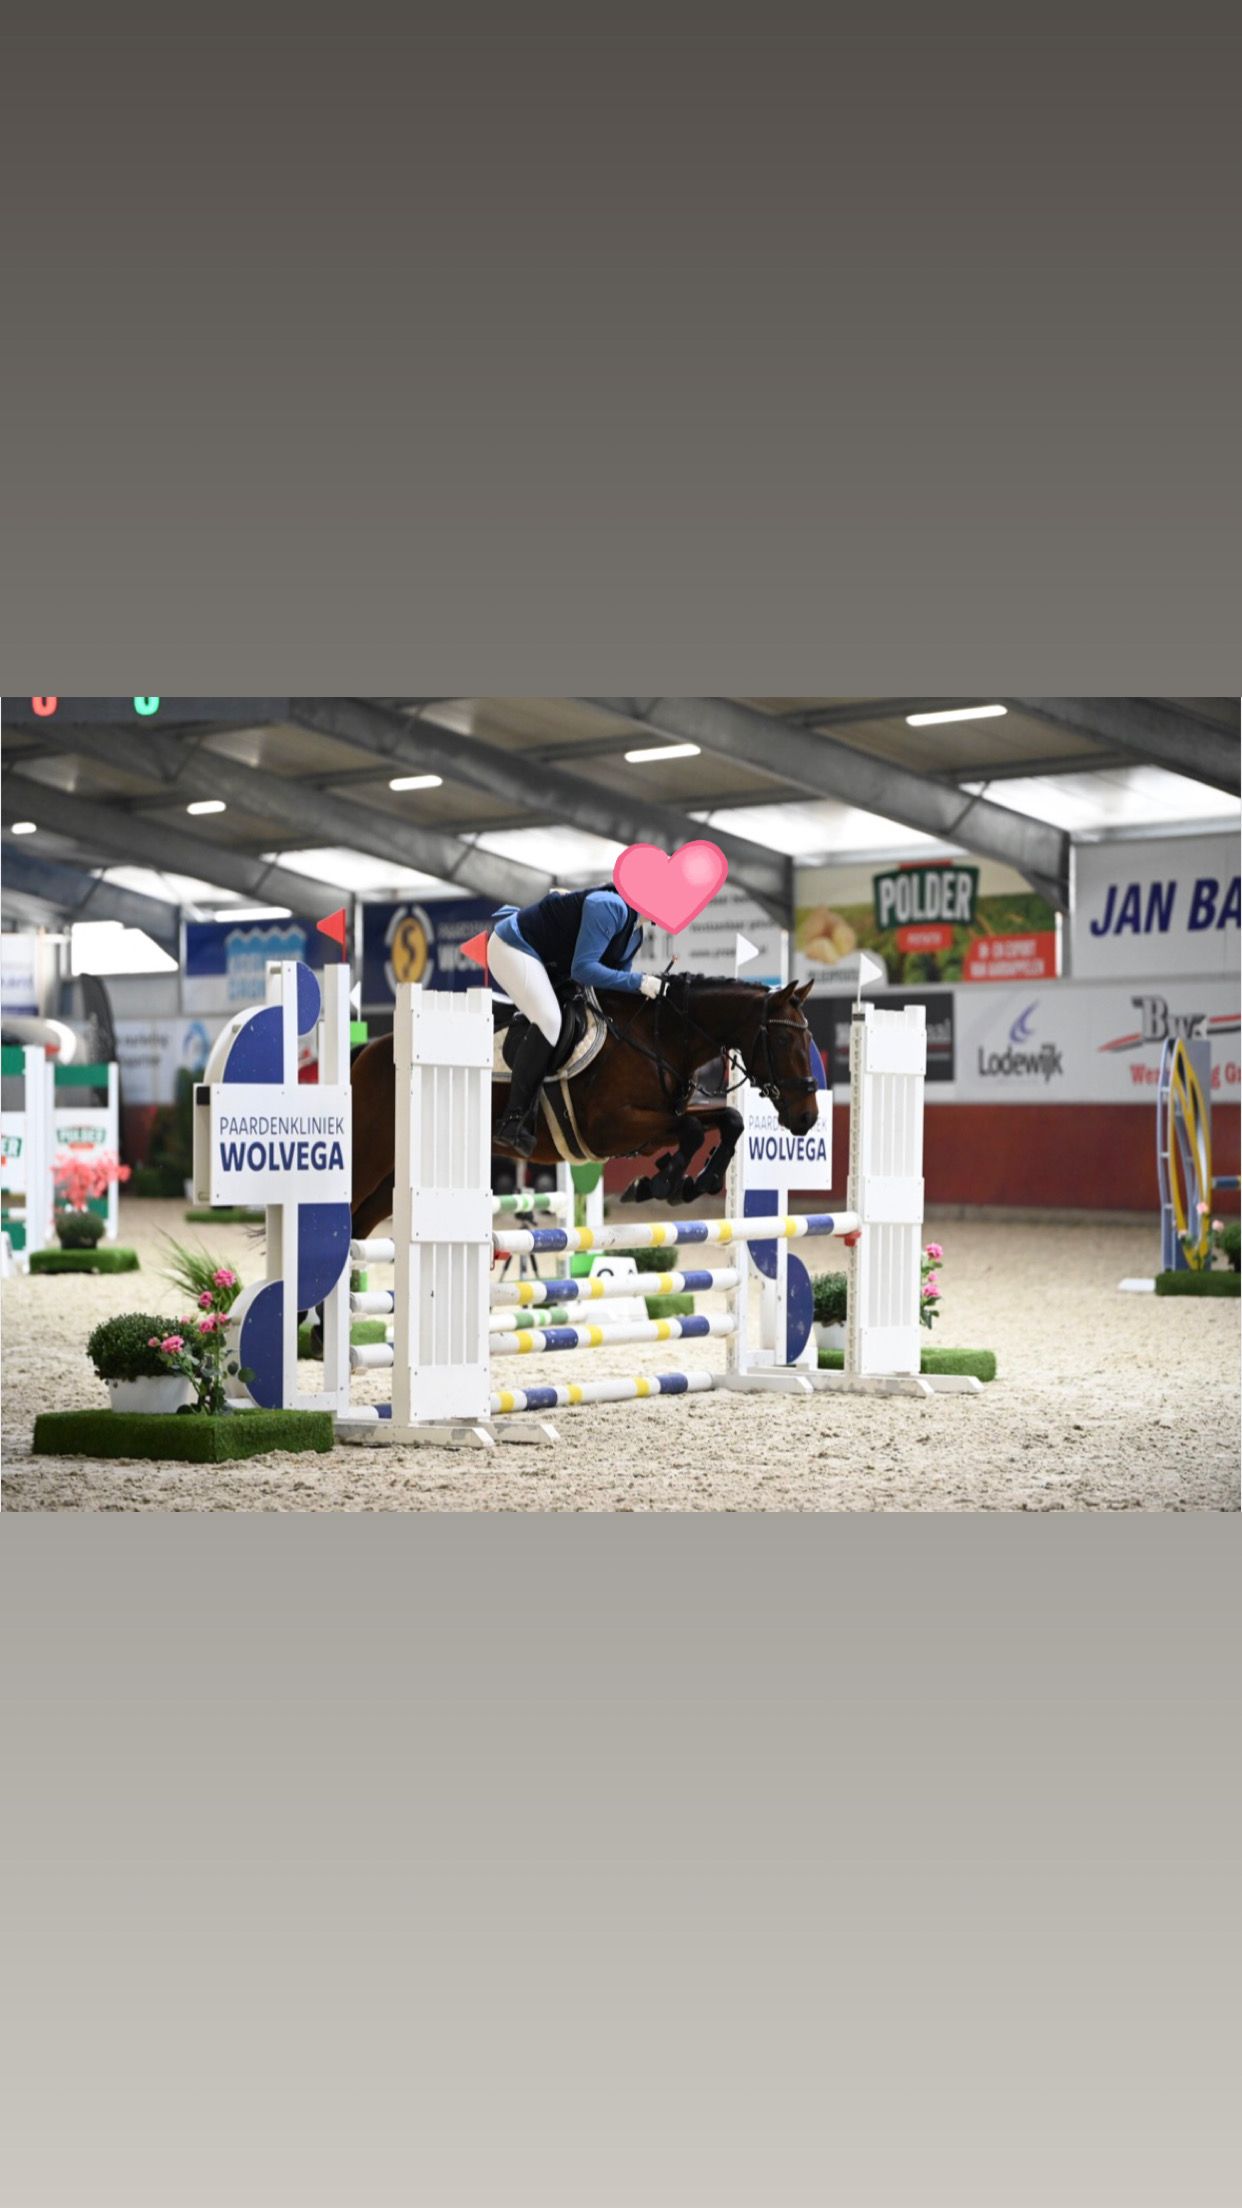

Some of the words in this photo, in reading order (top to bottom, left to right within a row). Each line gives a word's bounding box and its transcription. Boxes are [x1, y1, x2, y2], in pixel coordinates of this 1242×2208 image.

[879, 871, 973, 927] POLDER
[1090, 880, 1177, 938] JAN
[978, 1043, 1063, 1082] Lodewijk
[220, 1116, 344, 1135] PAARDENKLINIEK
[220, 1141, 344, 1172] WOLVEGA
[748, 1136, 827, 1162] WOLVEGA
